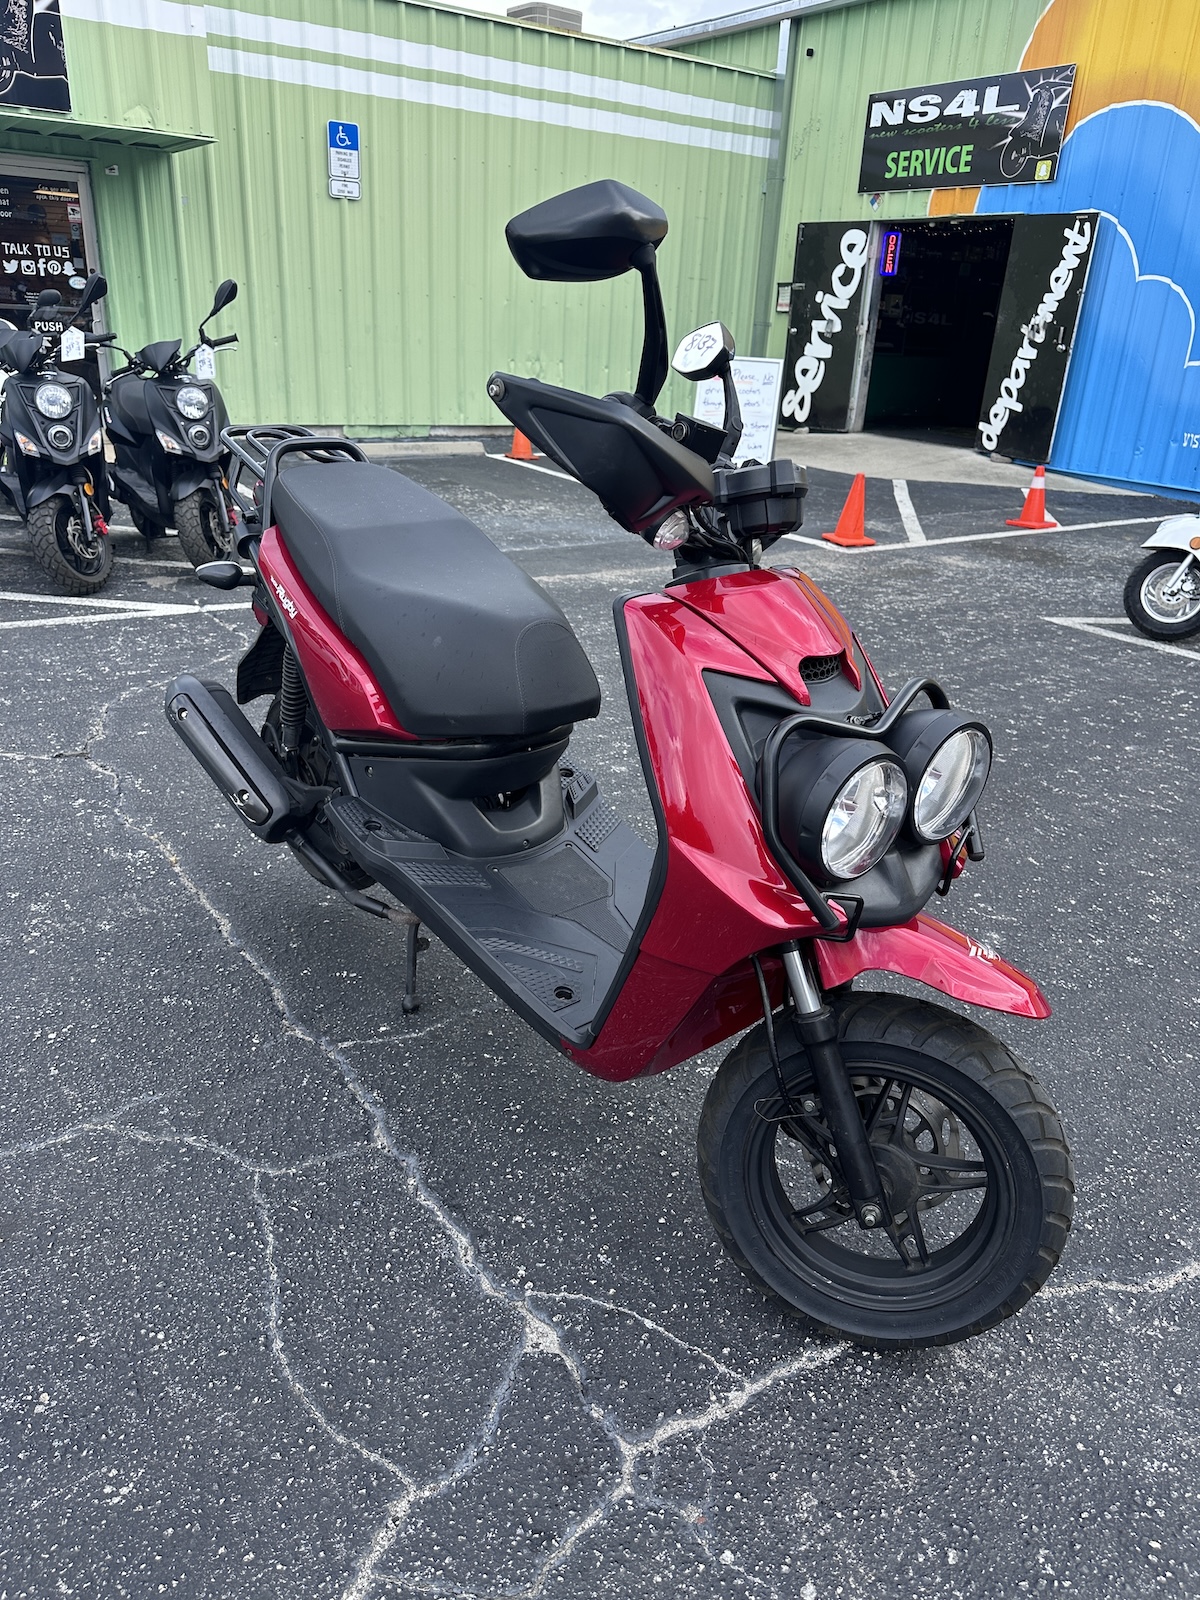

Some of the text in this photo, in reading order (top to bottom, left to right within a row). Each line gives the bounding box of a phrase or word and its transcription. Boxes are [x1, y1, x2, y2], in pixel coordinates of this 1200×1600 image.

[869, 85, 1020, 128] NS4L
[869, 114, 1019, 140] new scooters 4 less
[884, 144, 975, 179] SERVICE
[1, 242, 70, 258] TALK TO US
[885, 234, 898, 274] OPEN
[34, 321, 63, 331] PUSH
[782, 229, 869, 422] service
[978, 219, 1091, 451] department
[276, 583, 298, 619] Rugby
